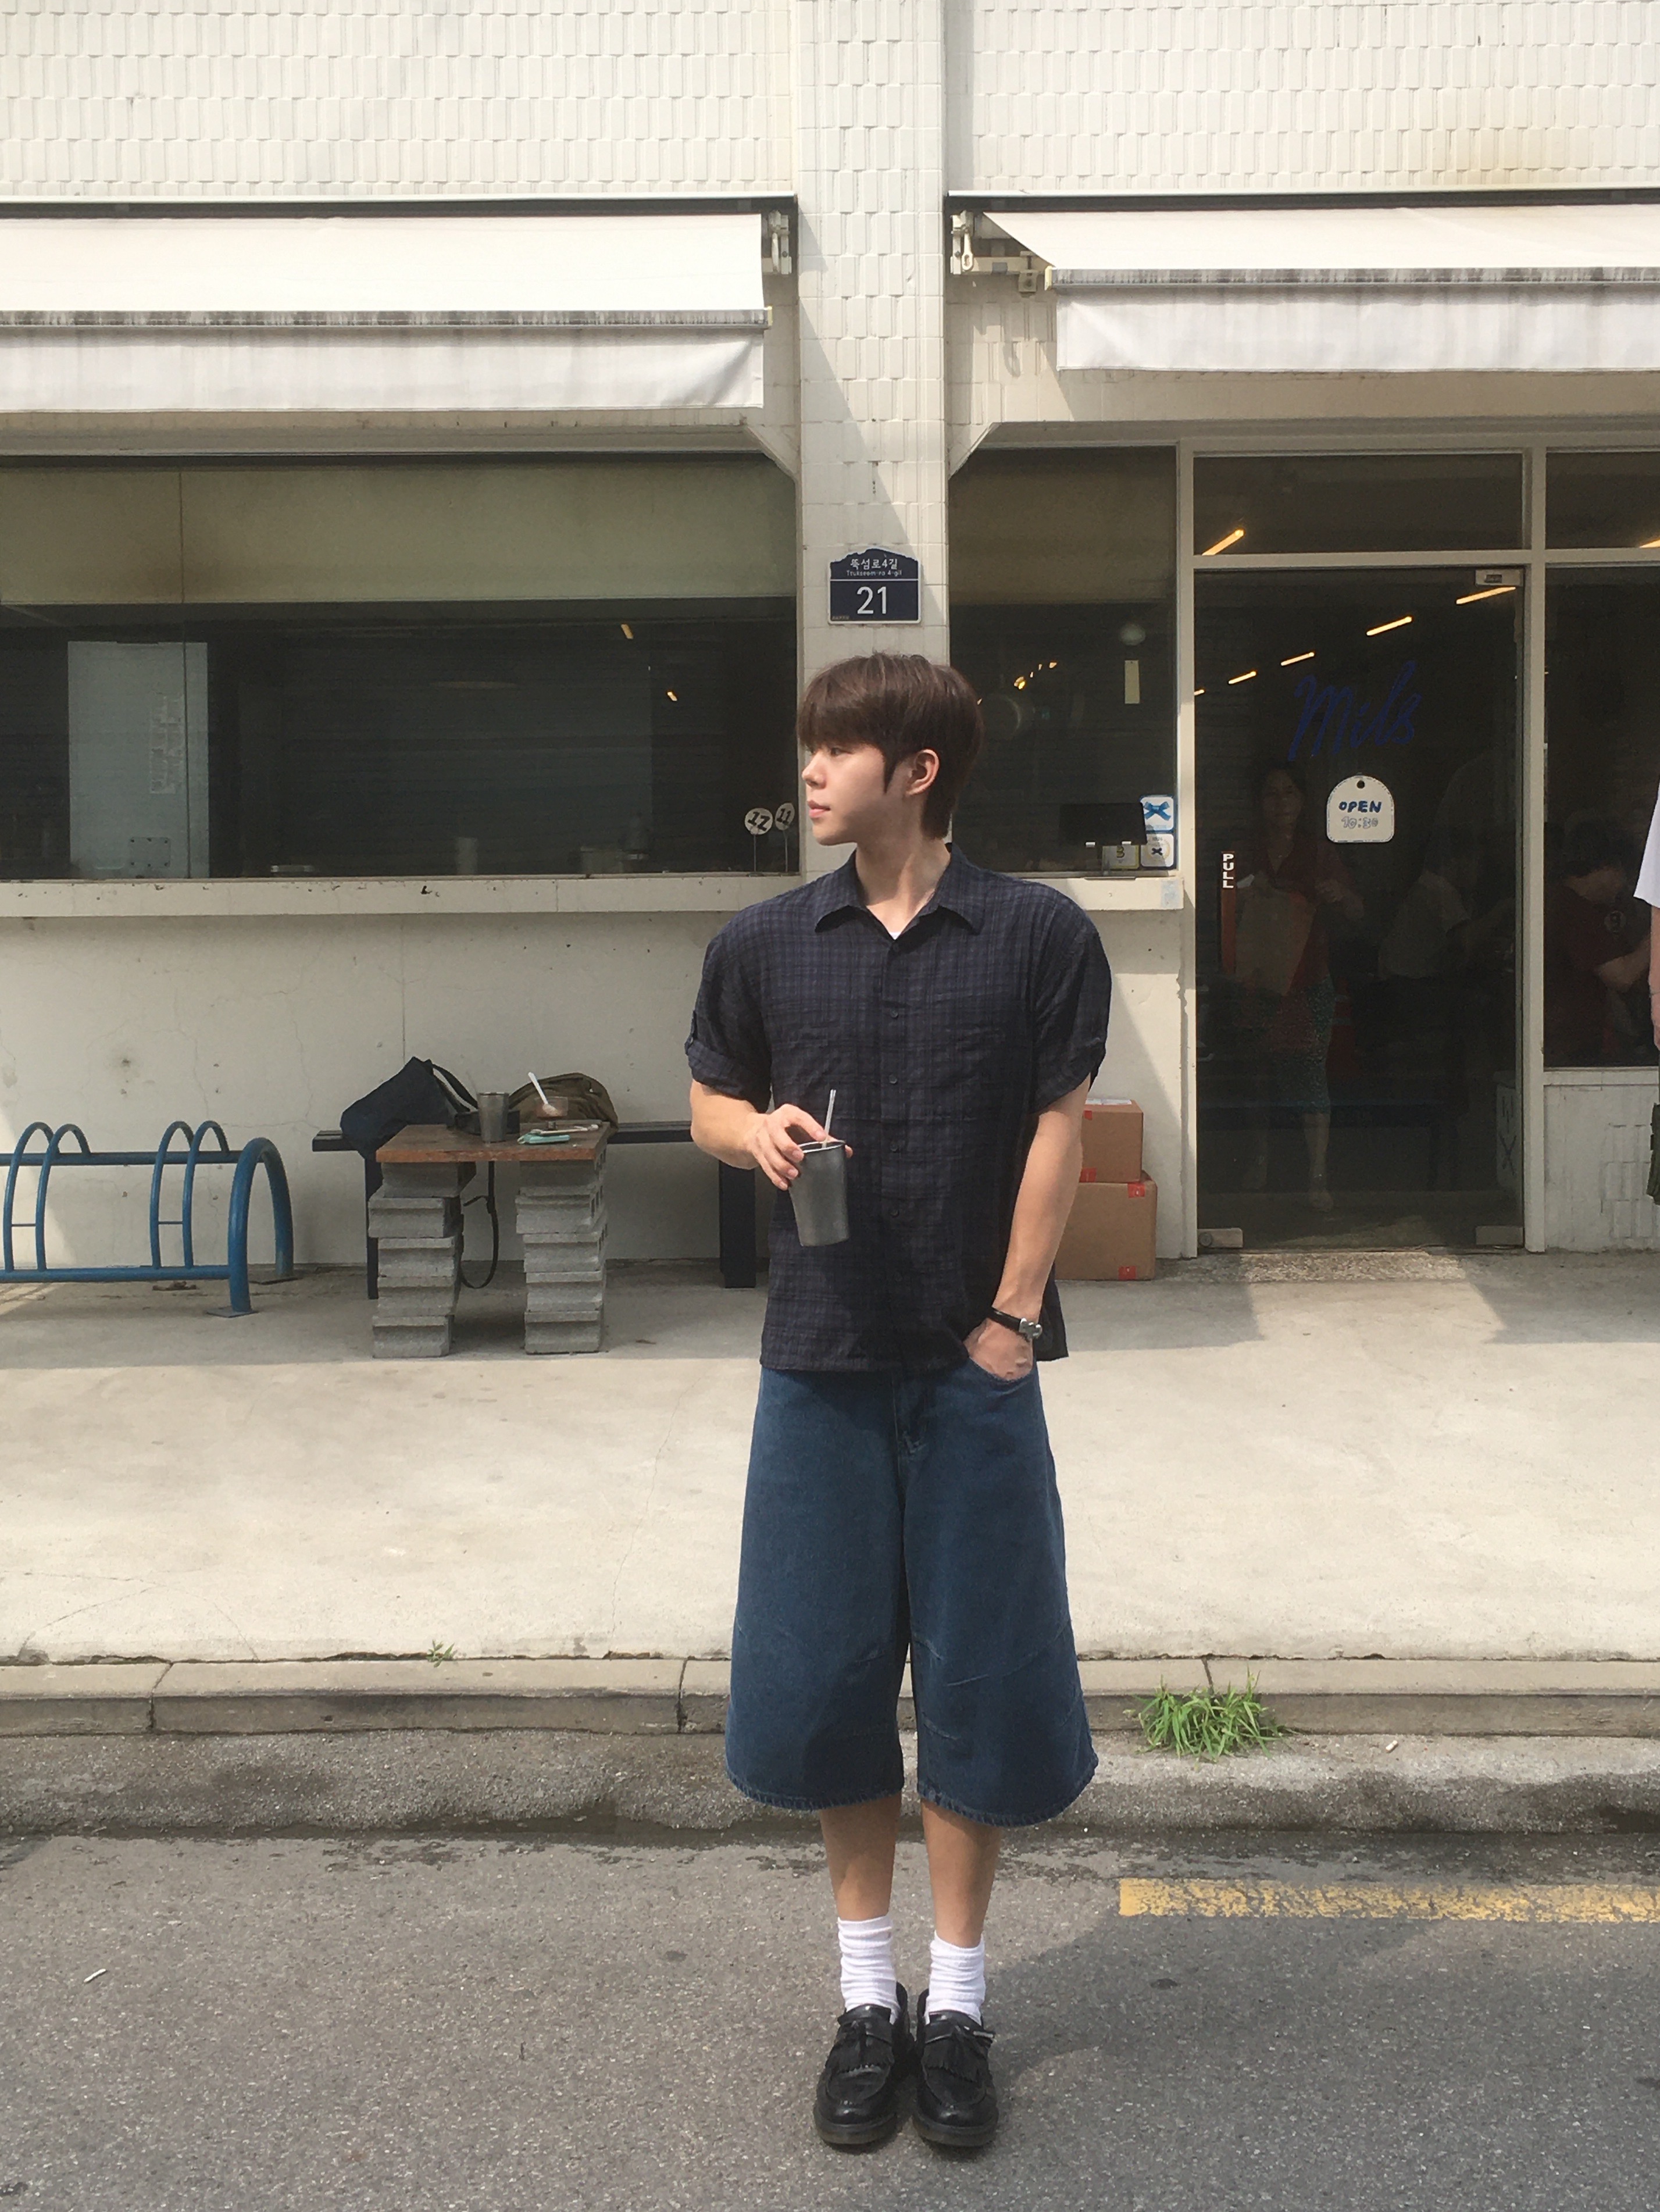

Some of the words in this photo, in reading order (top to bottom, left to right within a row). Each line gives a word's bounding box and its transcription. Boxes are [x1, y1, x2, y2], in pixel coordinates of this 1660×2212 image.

[850, 558, 898, 570] 뚝섬로4길
[856, 586, 887, 614] 21
[1338, 800, 1382, 813] OPEN
[1341, 815, 1379, 829] 10:30
[1222, 853, 1234, 889] PULL
